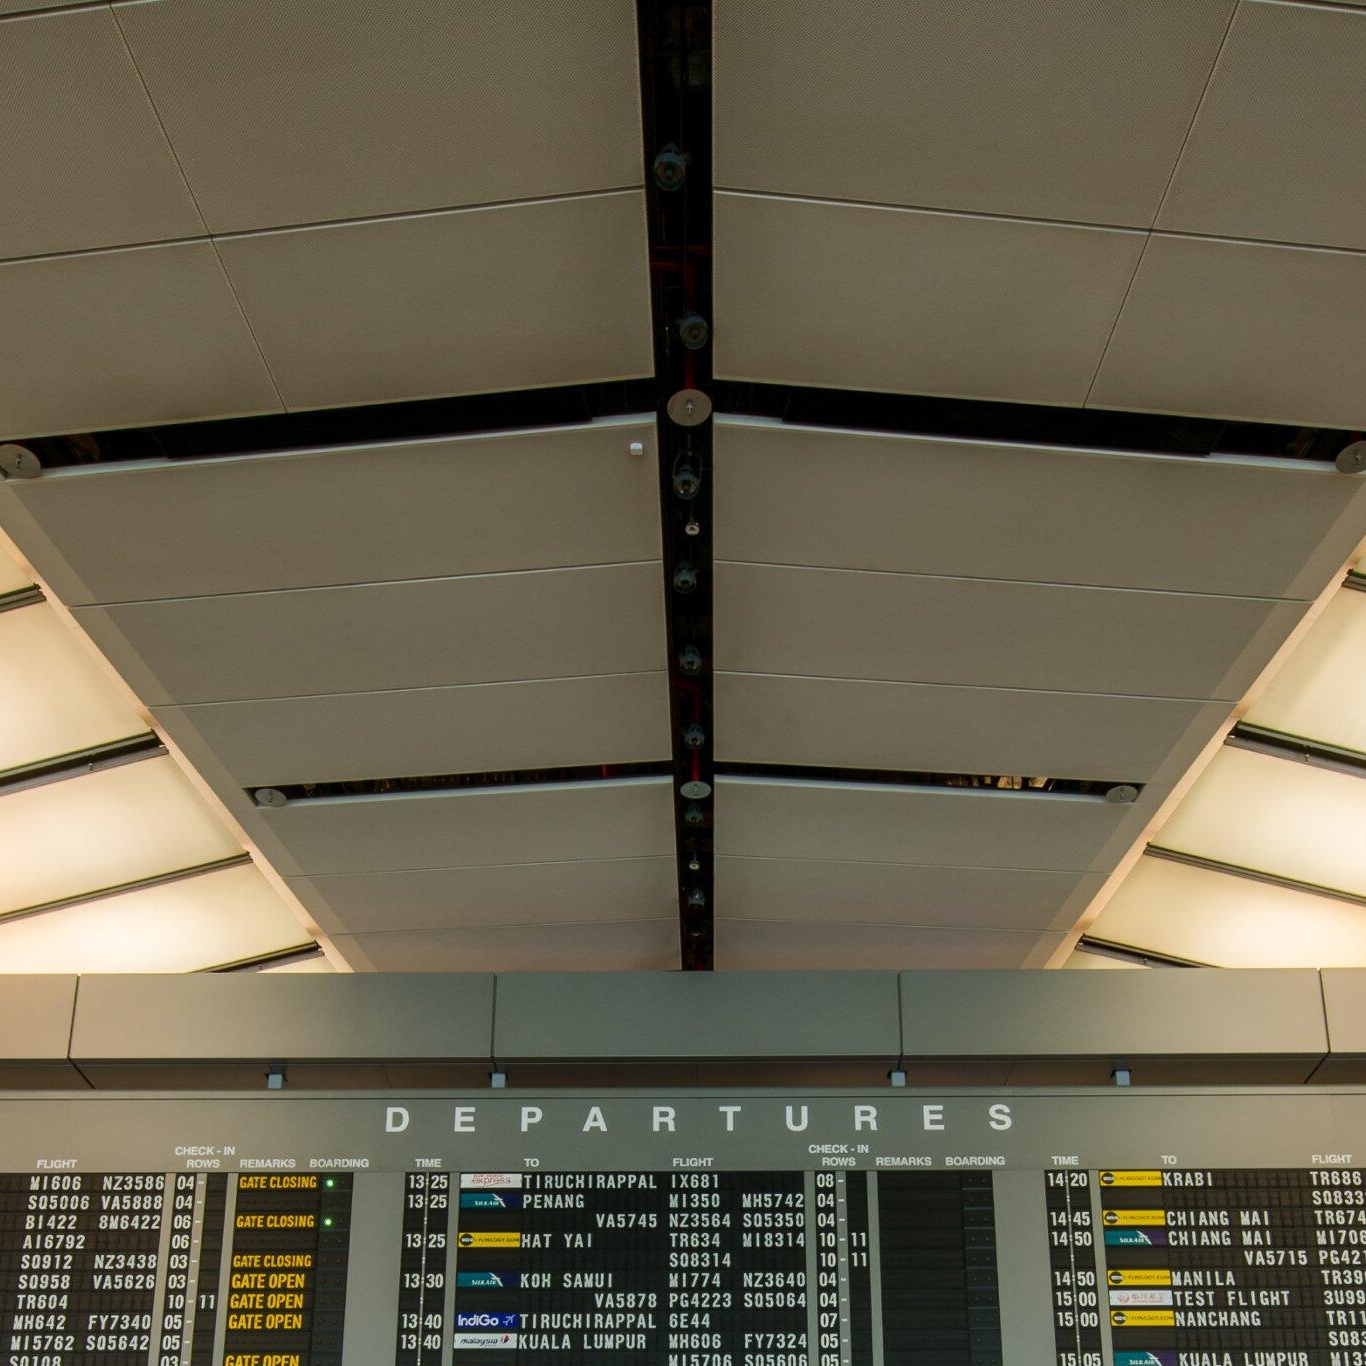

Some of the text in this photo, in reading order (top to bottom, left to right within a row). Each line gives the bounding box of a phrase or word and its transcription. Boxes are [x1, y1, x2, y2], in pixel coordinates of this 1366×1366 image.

[386, 1106, 1013, 1133] DEPARTURES
[175, 1146, 234, 1156] CHECK IN
[809, 1145, 868, 1153] CHECK IN
[186, 1160, 220, 1168] ROWS
[240, 1159, 295, 1168] REMARKS
[309, 1159, 368, 1168] BOARDING
[415, 1158, 441, 1167] TIME
[525, 1158, 539, 1167] TO
[673, 1158, 712, 1167] FLIGHT
[822, 1157, 856, 1166] ROWS
[876, 1157, 931, 1166] REMARKS
[946, 1157, 1005, 1166] BOARDING
[1052, 1156, 1078, 1165] TIME
[1161, 1156, 1177, 1165] TO
[1311, 1154, 1351, 1164] FLIGHT
[37, 1160, 76, 1169] FLIGHT
[523, 1175, 657, 1189] TIRUCHIRAPPAL
[1162, 1172, 1213, 1187] KRABI
[522, 1194, 584, 1208] PENANG
[1167, 1211, 1270, 1226] CHIANG MAI
[522, 1234, 594, 1248] HAT YAI
[1168, 1231, 1272, 1246] CHIANG MAI
[521, 1273, 613, 1288] KOH SAMUI
[1172, 1271, 1235, 1286] MANILA
[1173, 1291, 1290, 1306] TEST FLIGHT
[458, 1314, 499, 1327] IndiGo
[520, 1314, 656, 1329] TIRUCHIRAPPAL
[1176, 1312, 1261, 1327] NANCHANG
[519, 1334, 646, 1349] KUALA LUMPUR
